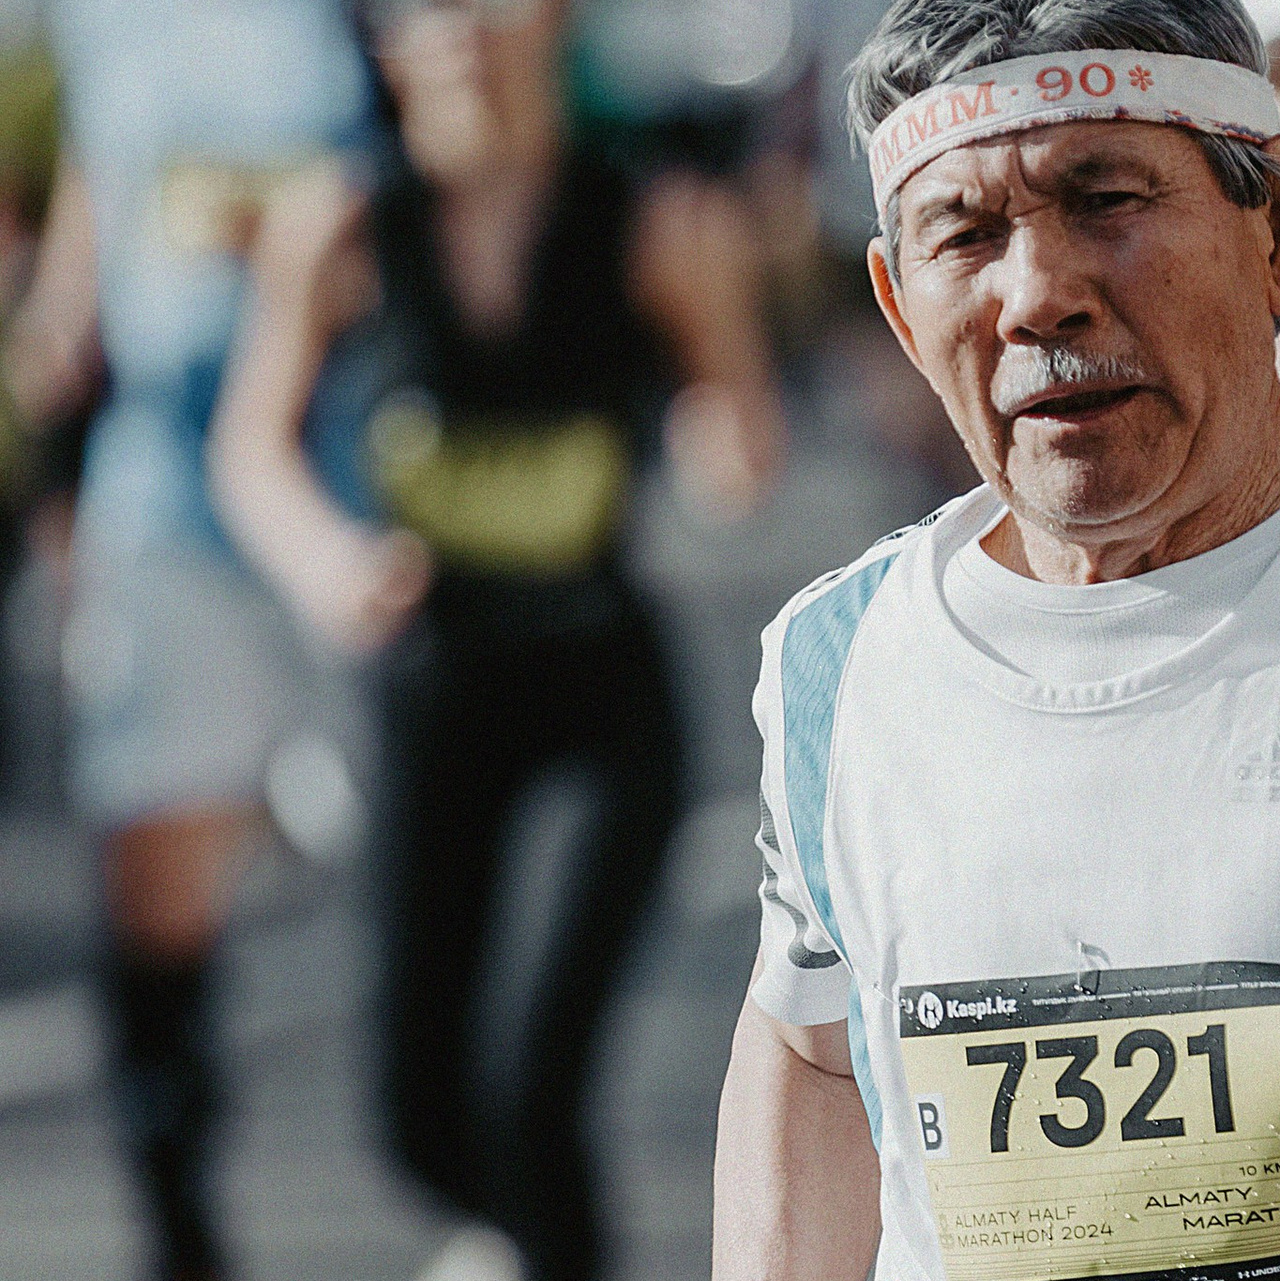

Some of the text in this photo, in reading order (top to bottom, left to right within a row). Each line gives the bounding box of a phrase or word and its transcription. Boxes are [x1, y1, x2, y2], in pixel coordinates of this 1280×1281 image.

[946, 996, 1017, 1020] Kaspi.kz
[966, 1024, 1235, 1153] 7321
[918, 1102, 942, 1150] B
[1239, 1165, 1257, 1176] 10
[1145, 1186, 1252, 1209] ALMATY
[955, 1206, 1077, 1228] ALMATY HALF
[957, 1222, 1114, 1248] MARATHON 2024
